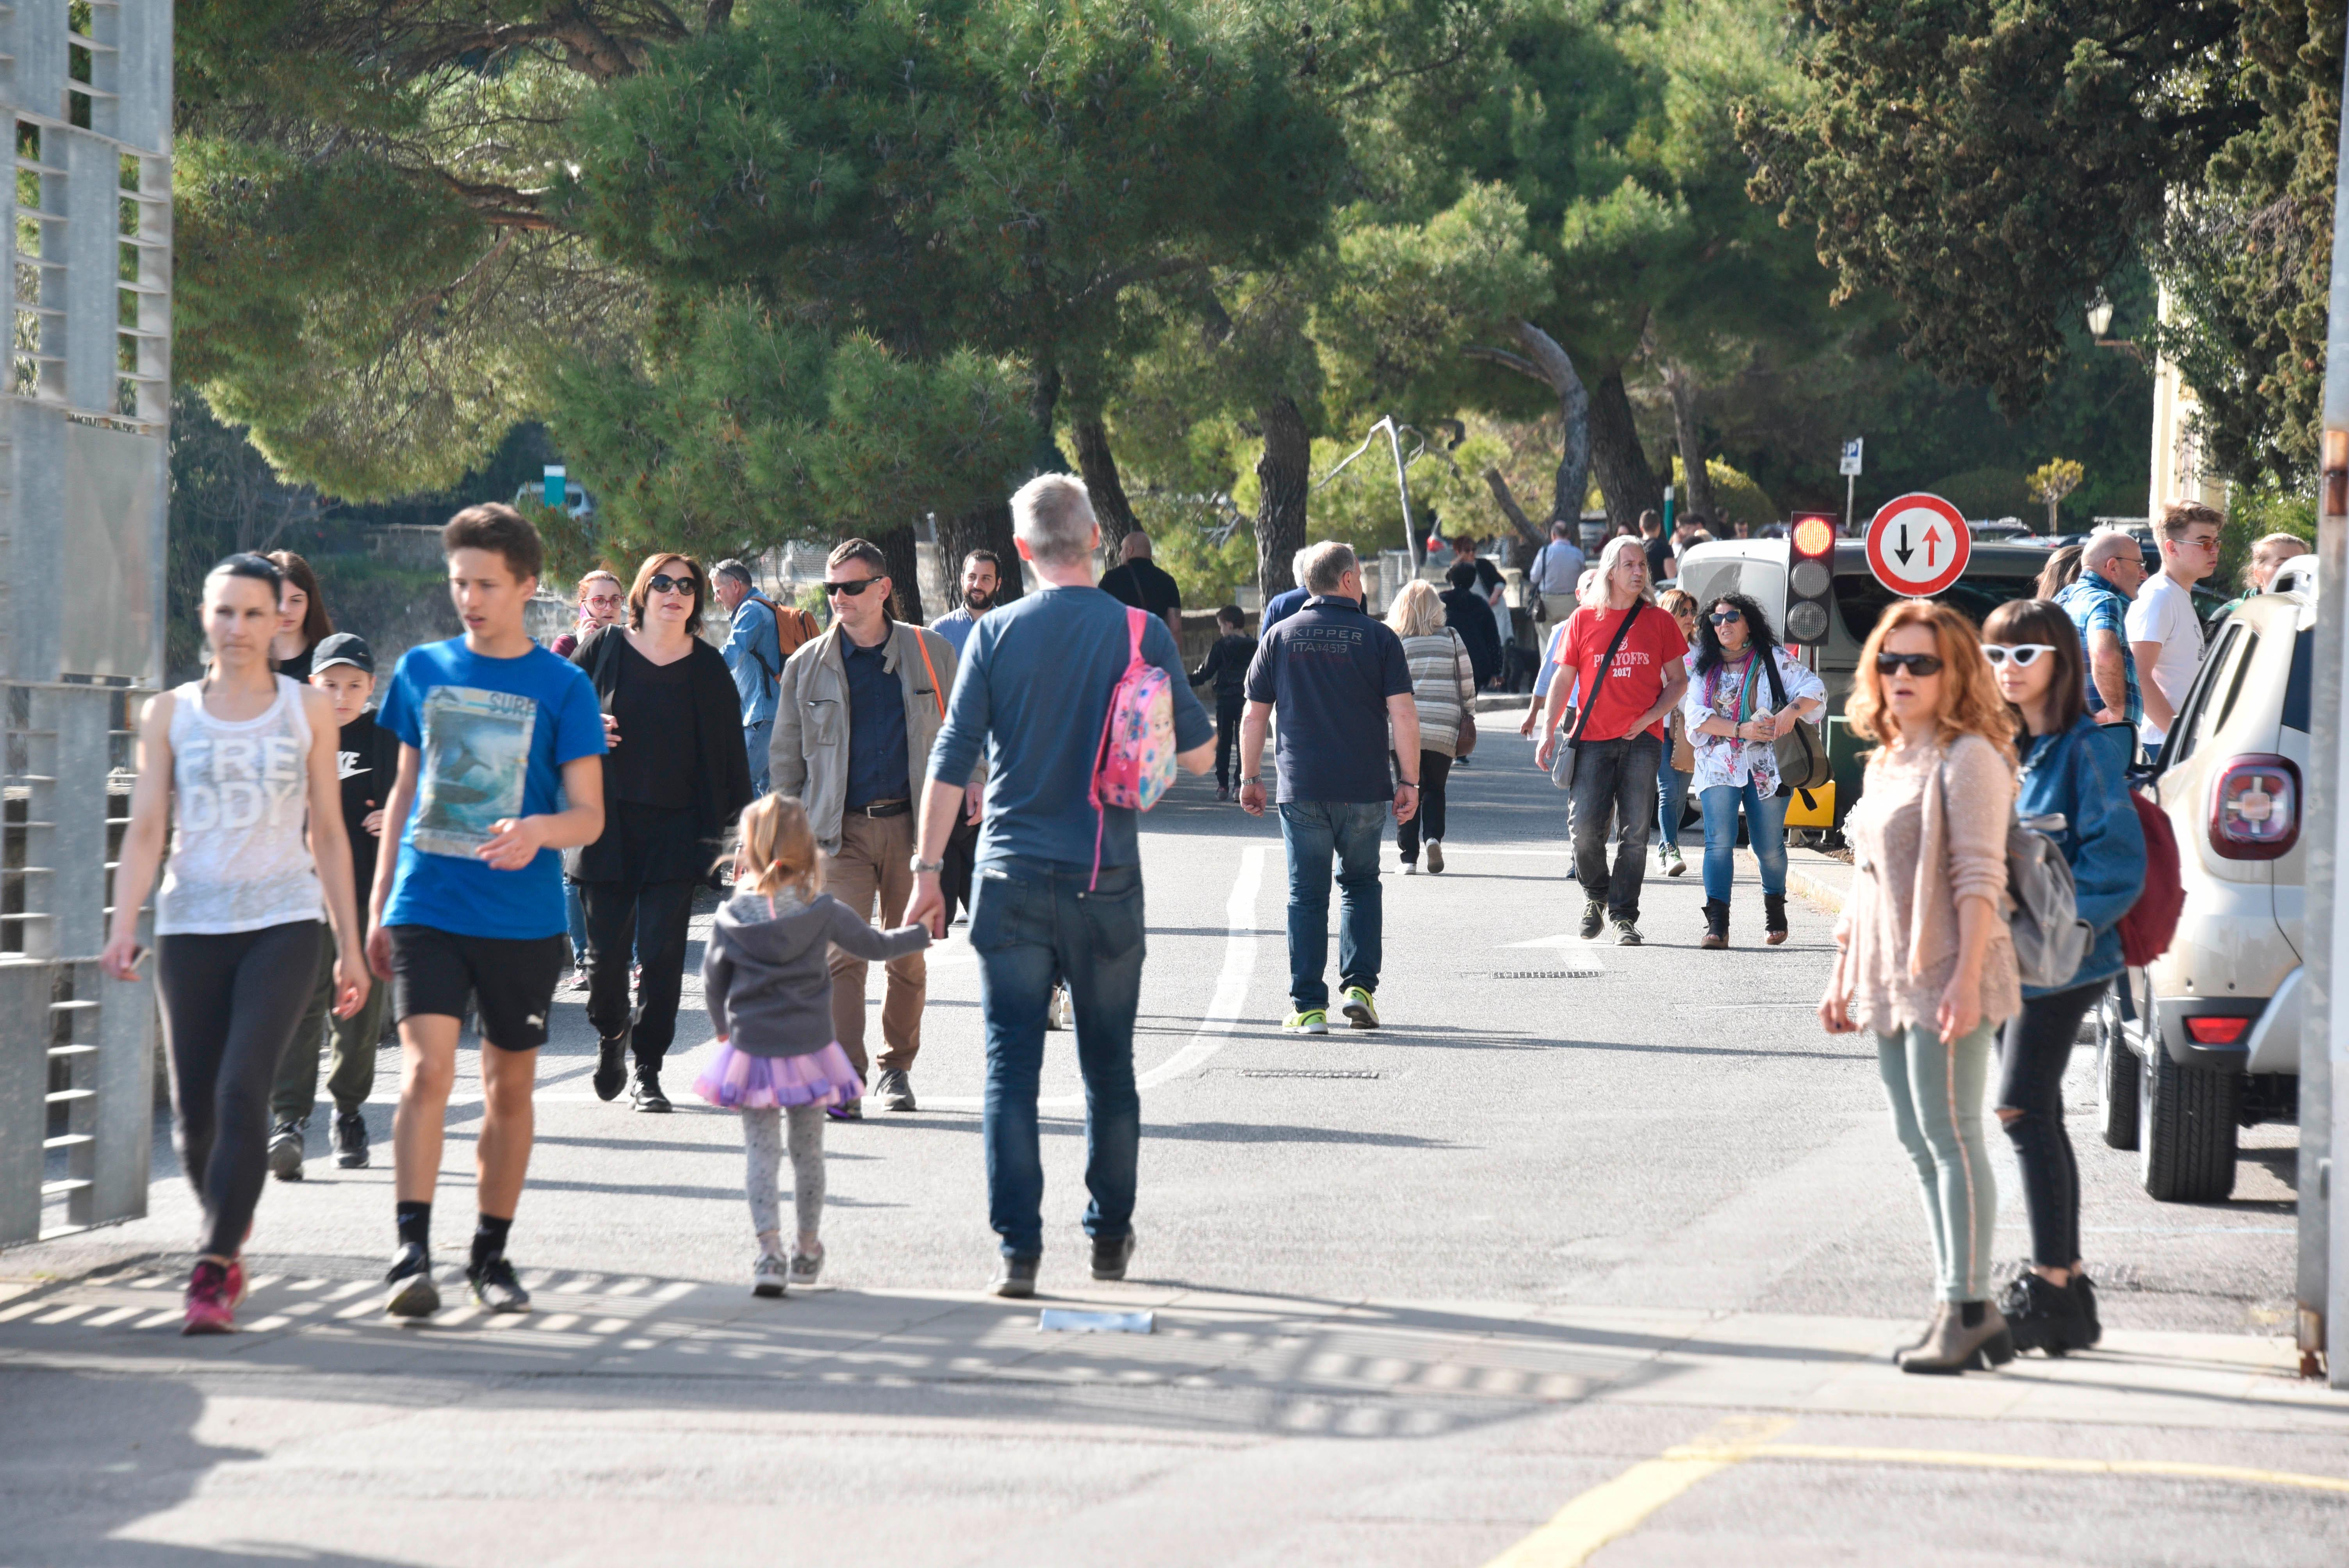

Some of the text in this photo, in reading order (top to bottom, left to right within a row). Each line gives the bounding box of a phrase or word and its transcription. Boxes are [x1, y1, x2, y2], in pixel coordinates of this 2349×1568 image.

[1847, 442, 1857, 456] P
[1281, 629, 1362, 641] SKIPPER
[1293, 642, 1316, 652] ITA
[1613, 666, 1631, 678] 2017
[177, 738, 299, 782] FRE
[337, 751, 361, 772] KE
[182, 781, 297, 832] DDY
